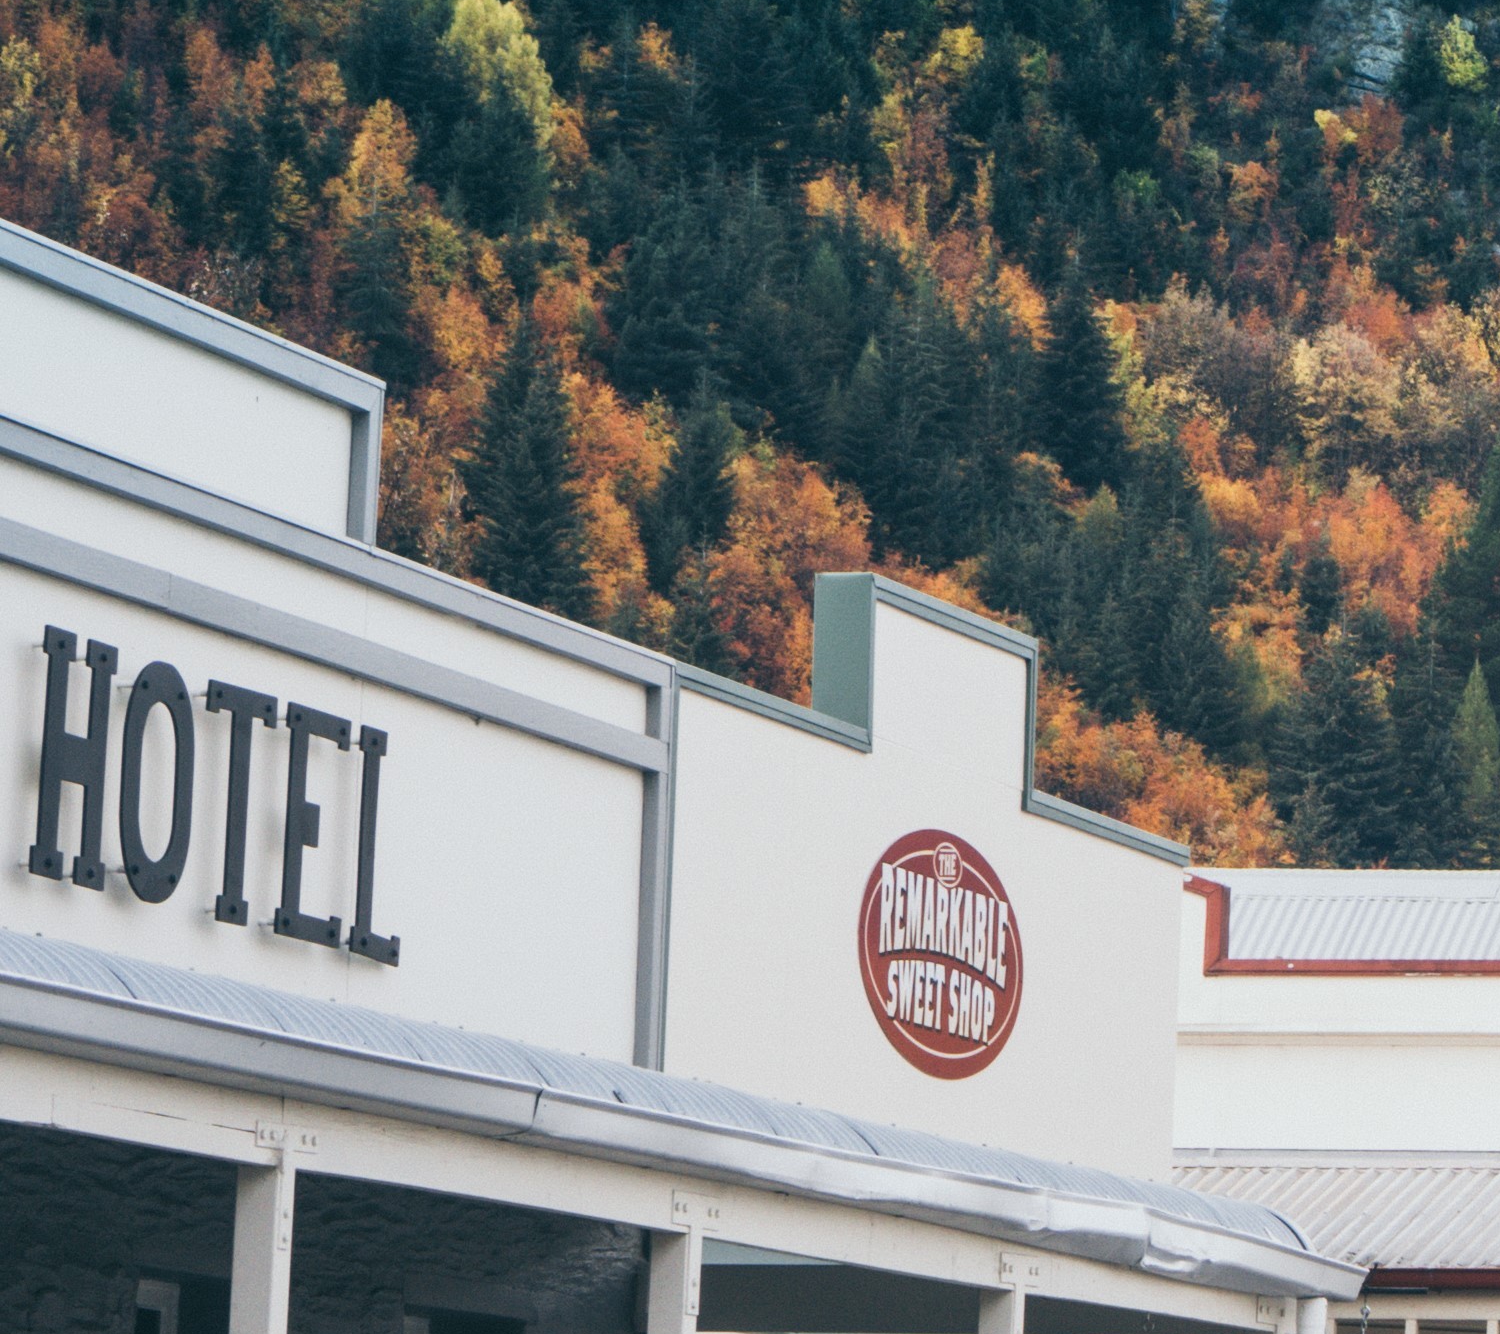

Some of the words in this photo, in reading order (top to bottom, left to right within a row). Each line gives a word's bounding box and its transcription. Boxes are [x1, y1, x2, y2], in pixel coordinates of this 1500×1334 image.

[28, 624, 401, 967] HOTEL
[937, 853, 957, 878] THE
[878, 862, 1009, 990] REMARKABLE
[886, 959, 946, 1032] SWEET
[948, 968, 996, 1045] SHOP
